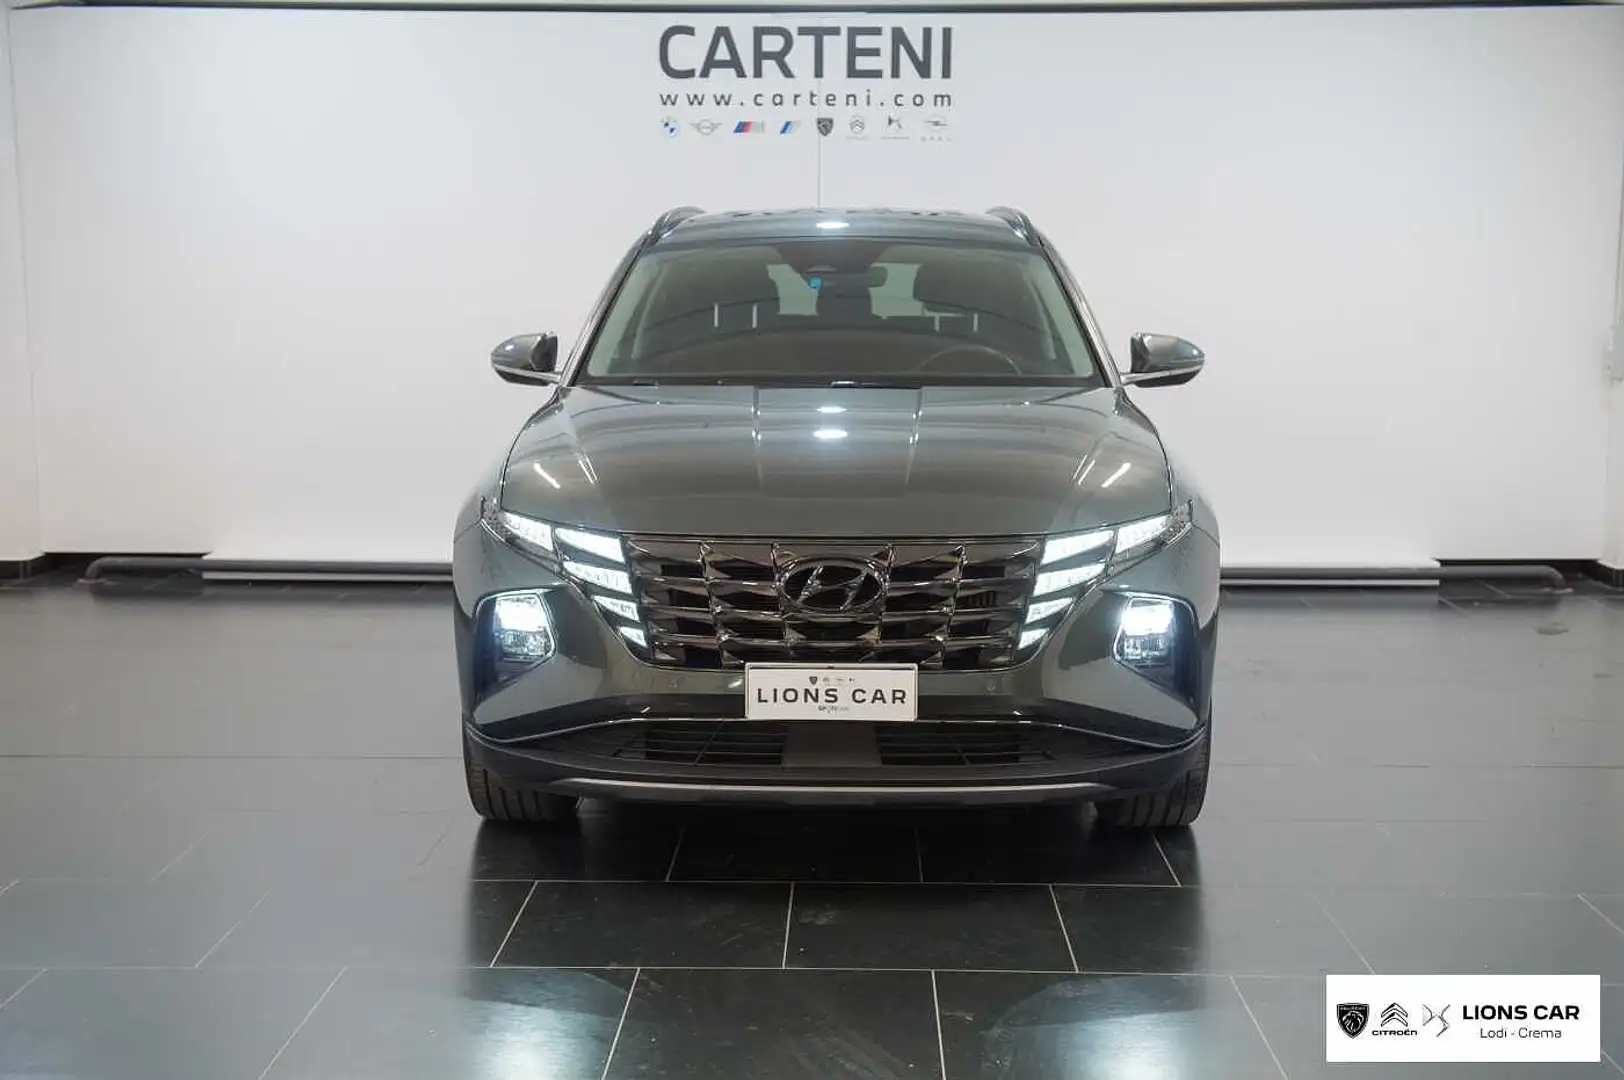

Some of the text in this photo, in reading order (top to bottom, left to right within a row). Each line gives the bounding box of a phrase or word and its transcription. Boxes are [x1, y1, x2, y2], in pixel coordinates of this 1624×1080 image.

[659, 25, 952, 79] CARTENI
[659, 88, 952, 107] www.carteni.com
[757, 687, 907, 705] LIONS CAR
